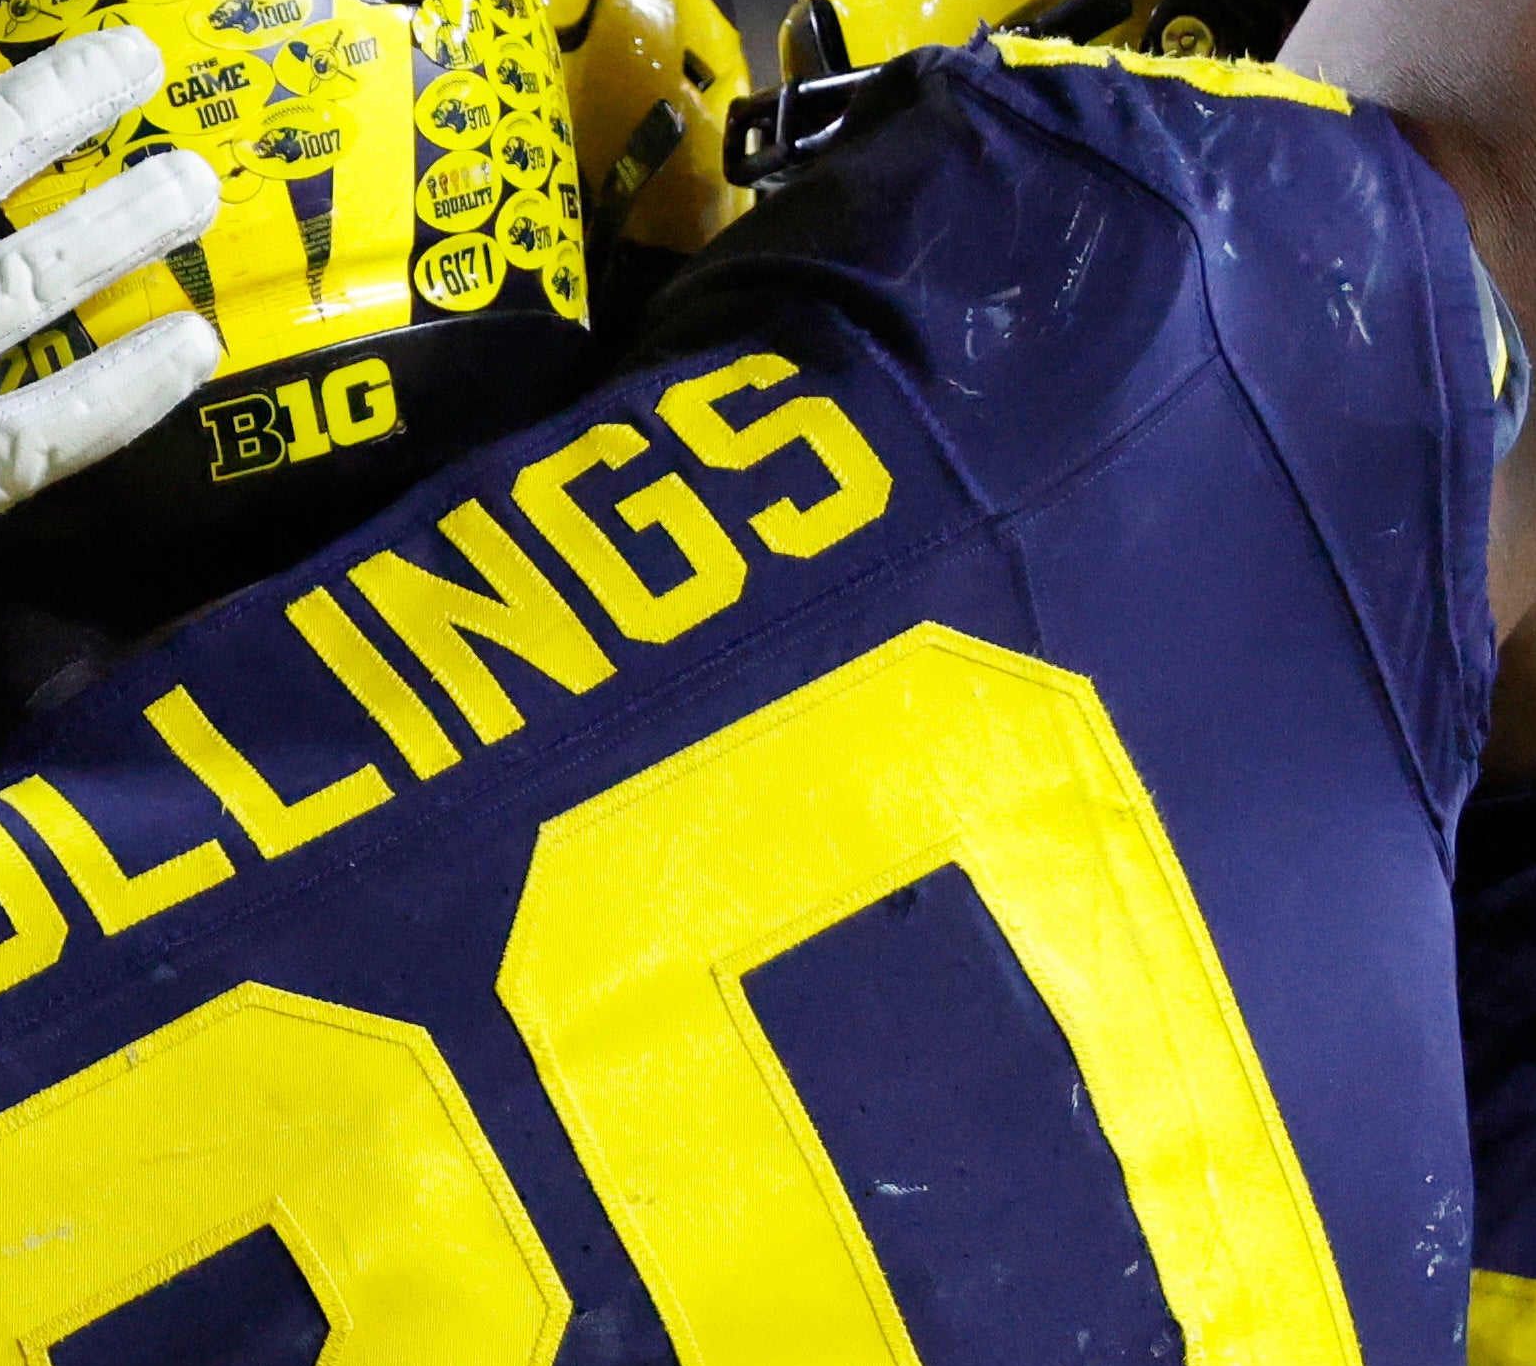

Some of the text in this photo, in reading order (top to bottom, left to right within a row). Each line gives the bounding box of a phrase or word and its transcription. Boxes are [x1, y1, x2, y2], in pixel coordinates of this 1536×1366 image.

[185, 57, 219, 73] THE
[342, 37, 380, 67] 1007
[166, 62, 251, 108] GAME
[196, 98, 240, 129] 1001
[467, 103, 491, 130] 970
[301, 129, 341, 160] 1007
[433, 186, 493, 220] EQUALITY
